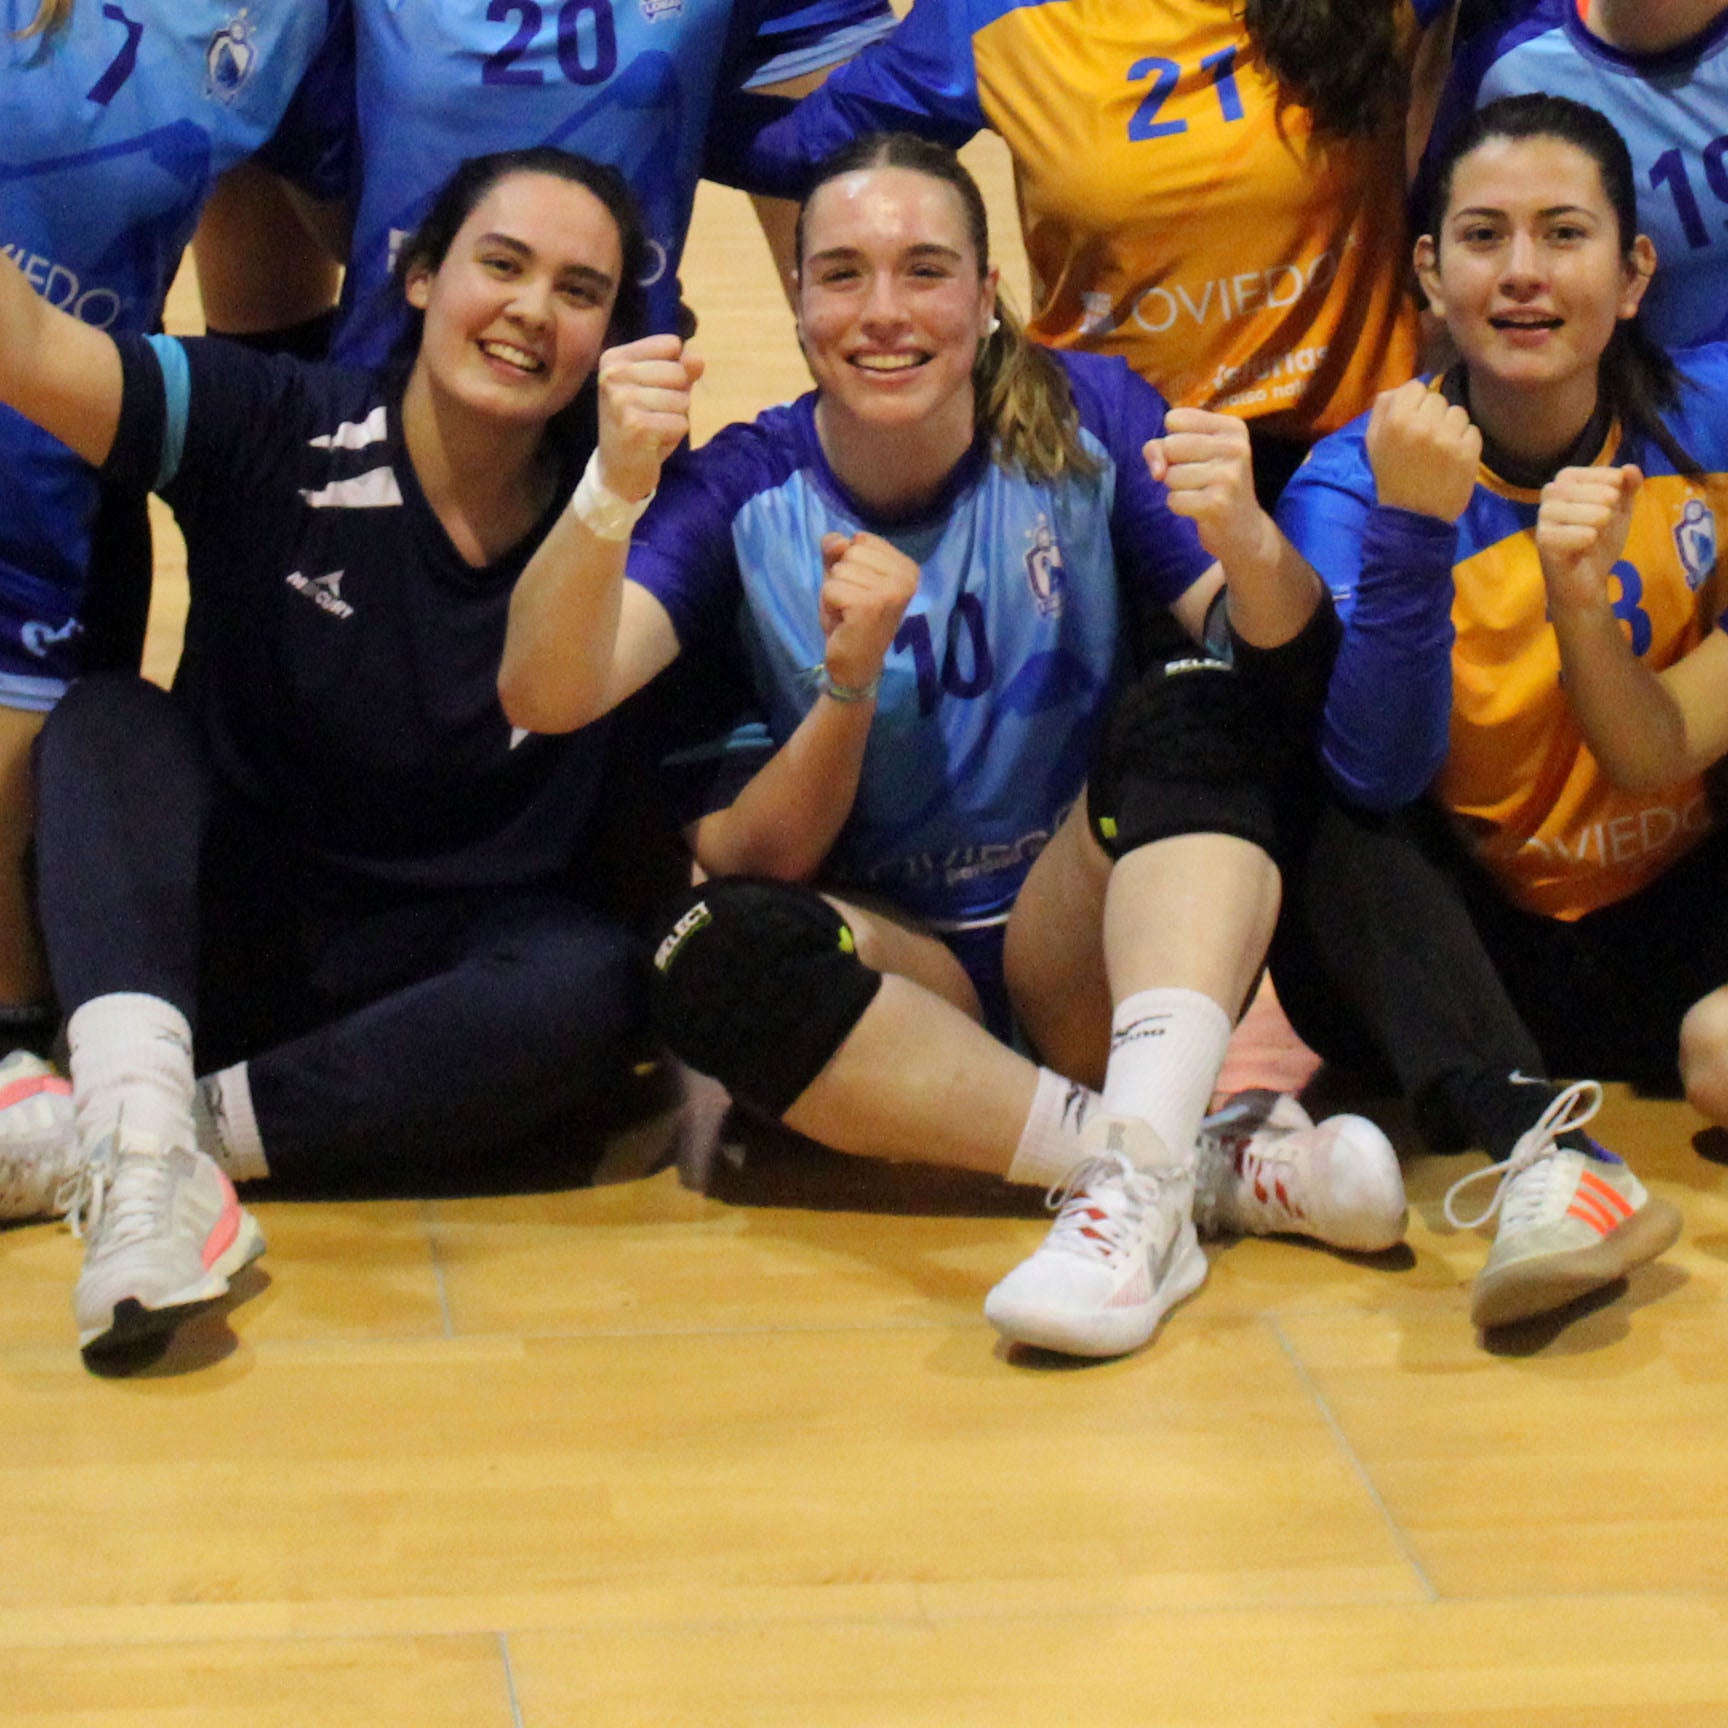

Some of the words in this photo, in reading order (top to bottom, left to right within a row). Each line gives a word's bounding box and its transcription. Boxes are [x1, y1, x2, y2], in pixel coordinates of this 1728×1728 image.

[87, 3, 143, 107] 7
[1125, 44, 1246, 143] 21
[1132, 252, 1339, 333] OVIEDO
[893, 591, 995, 718] 10
[653, 900, 710, 971] SELECT
